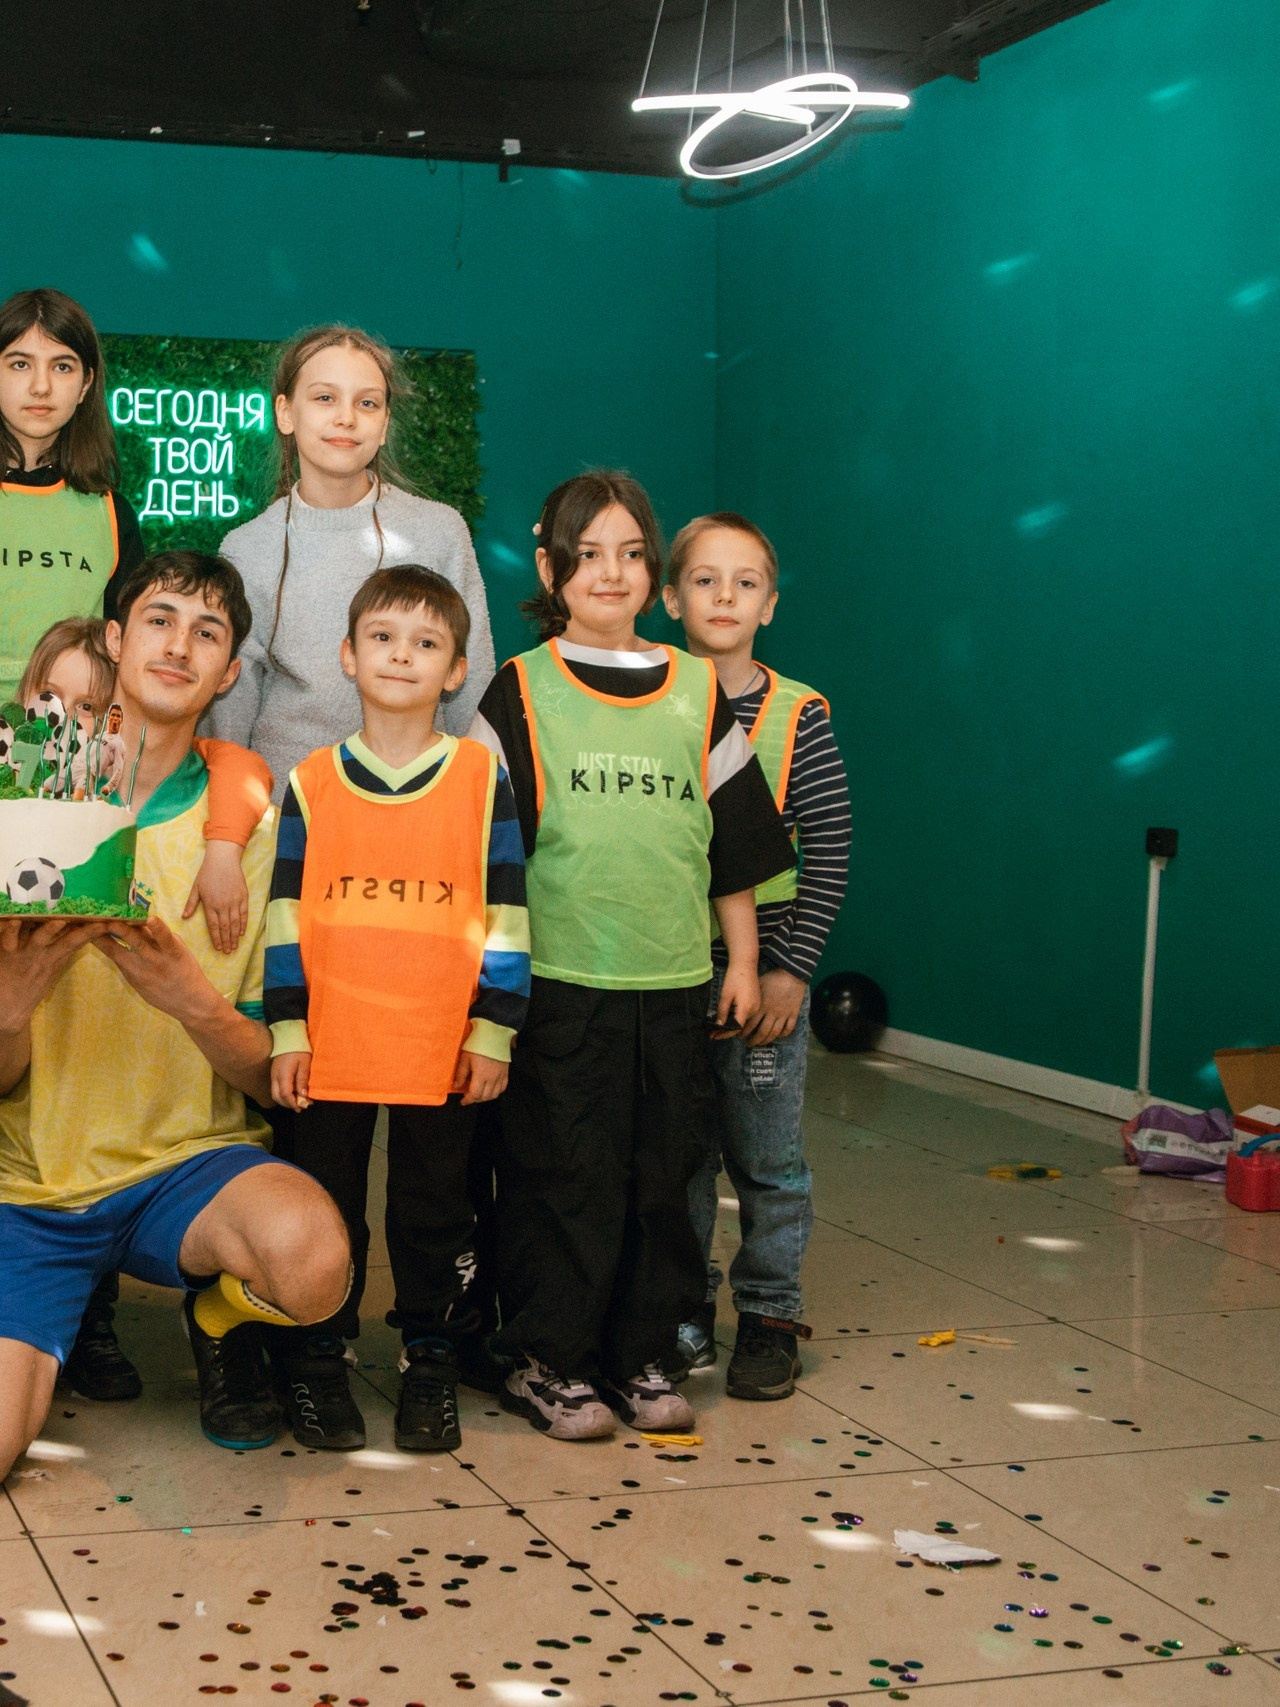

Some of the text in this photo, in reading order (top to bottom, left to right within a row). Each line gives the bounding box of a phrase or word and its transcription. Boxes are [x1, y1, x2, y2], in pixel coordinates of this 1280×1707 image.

[111, 387, 267, 434] СЕГОДНЯ
[147, 432, 235, 475] ТВОЙ
[138, 478, 240, 523] ДЕНЬ
[571, 768, 695, 801] KIPSTA
[578, 751, 662, 779] JUST STAY
